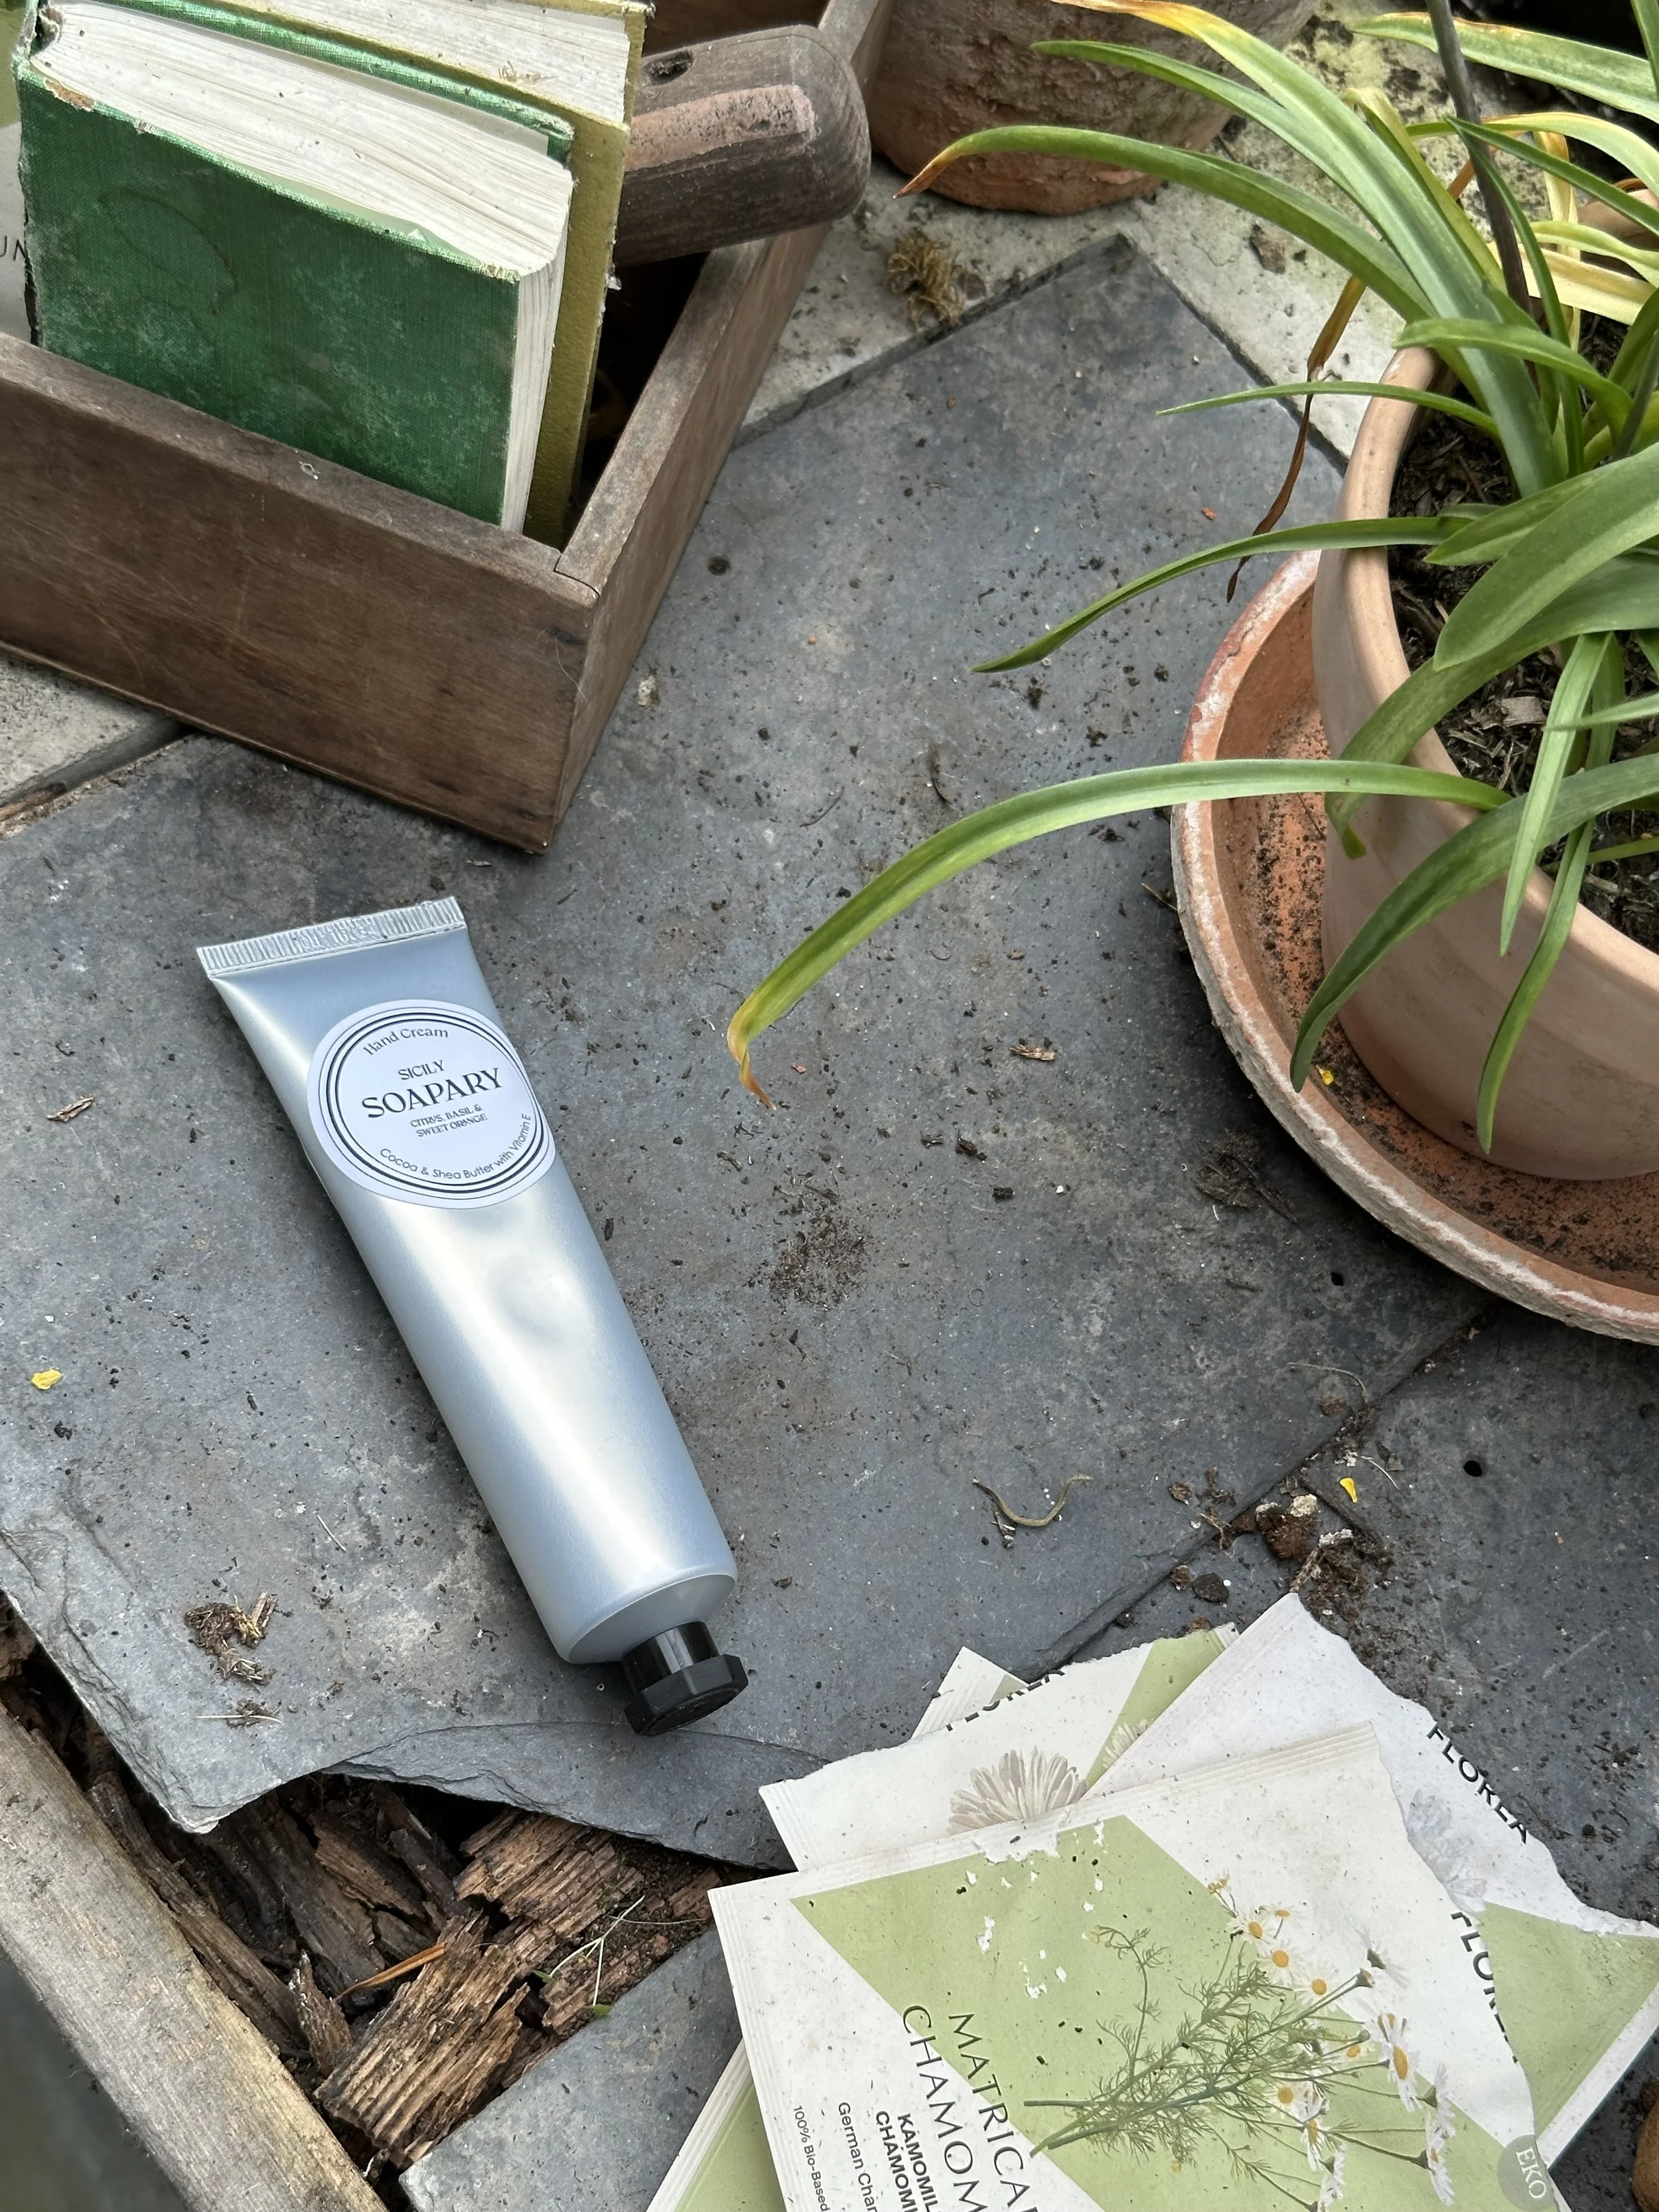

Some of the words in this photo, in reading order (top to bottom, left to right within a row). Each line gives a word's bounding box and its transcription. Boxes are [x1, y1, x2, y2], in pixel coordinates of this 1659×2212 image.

[362, 1030, 400, 1056] Hand
[400, 1028, 449, 1039] Cream
[361, 1067, 503, 1118] SOAPARY
[397, 1059, 445, 1080] SICILY
[415, 1123, 449, 1138] SWEET
[449, 1112, 488, 1130] ORANGE
[445, 1106, 474, 1120] BASIL
[473, 1104, 483, 1112] &
[380, 1147, 419, 1173] Cocoa
[420, 1167, 430, 1176] &
[432, 1169, 462, 1180] Shea
[463, 1163, 494, 1179] Butter
[493, 1151, 515, 1167] with
[508, 1121, 532, 1151] Vitamin
[838, 2102, 864, 2170] German
[948, 2013, 1039, 2212] MATRICA
[794, 2104, 811, 2143] 100%
[804, 2144, 831, 2212] Bio-Based
[1515, 2145, 1548, 2199] EKO
